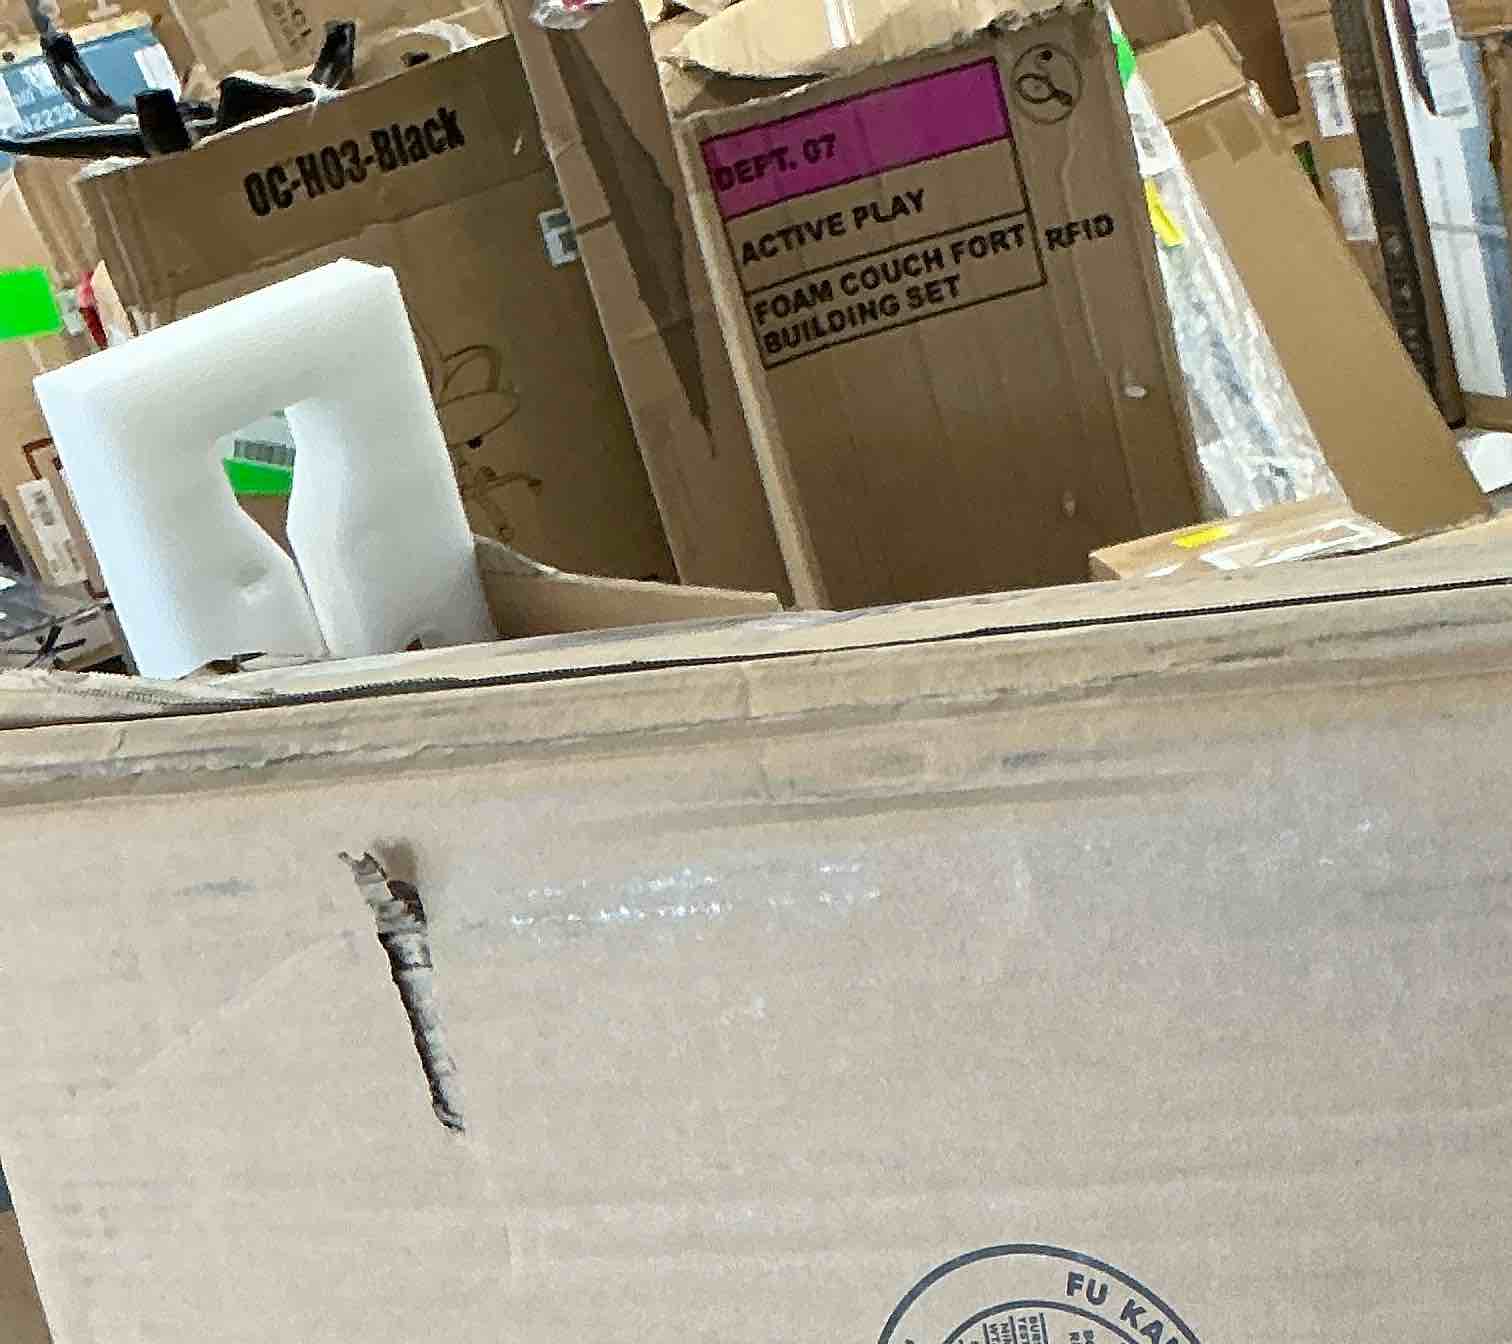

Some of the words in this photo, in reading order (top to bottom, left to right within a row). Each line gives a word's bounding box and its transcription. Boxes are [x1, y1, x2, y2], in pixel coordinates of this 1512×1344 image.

[244, 107, 465, 217] OC-H03-Black
[716, 148, 797, 192] DEPT.
[803, 133, 838, 163] 07
[741, 213, 847, 266] ACTIVE
[853, 189, 925, 231] PLAY
[1044, 213, 1115, 252] RFID
[753, 279, 833, 325] FOAM
[840, 248, 944, 297] COUCH
[953, 224, 1025, 265] FORT
[763, 292, 899, 354] BUILDING
[906, 274, 961, 309] SET
[1066, 1272, 1109, 1306] FU
